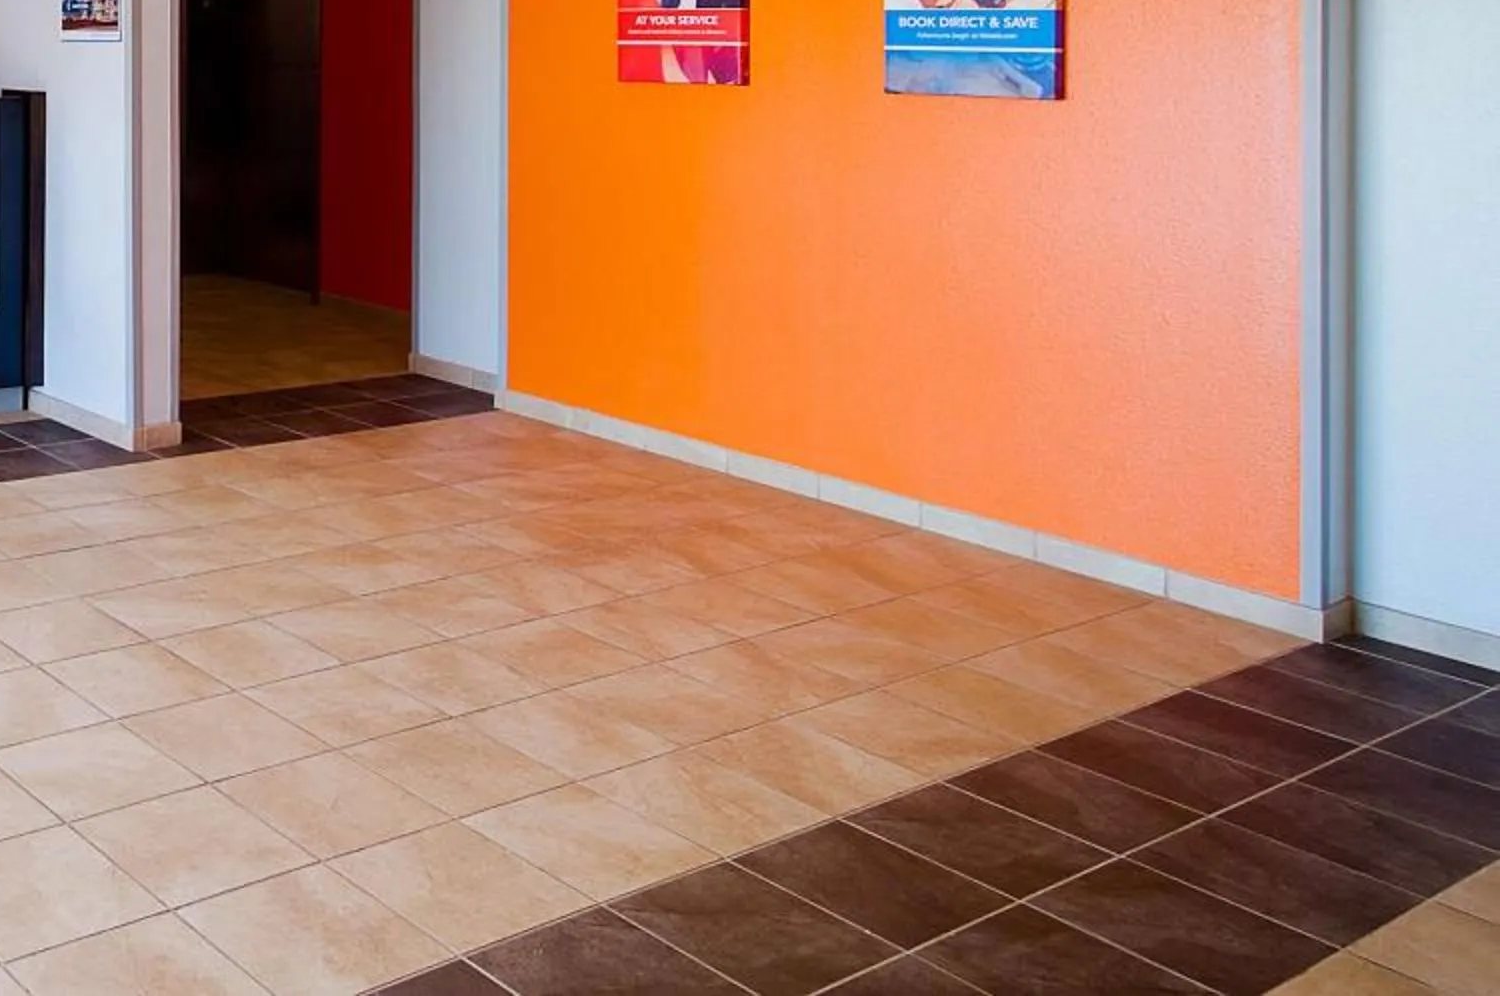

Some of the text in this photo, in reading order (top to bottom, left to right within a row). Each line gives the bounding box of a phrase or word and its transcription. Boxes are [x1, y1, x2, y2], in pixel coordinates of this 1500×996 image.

[635, 15, 719, 25] AT YOUR SERVICE
[898, 15, 1040, 29] BOOK DIRECT & SAVE
